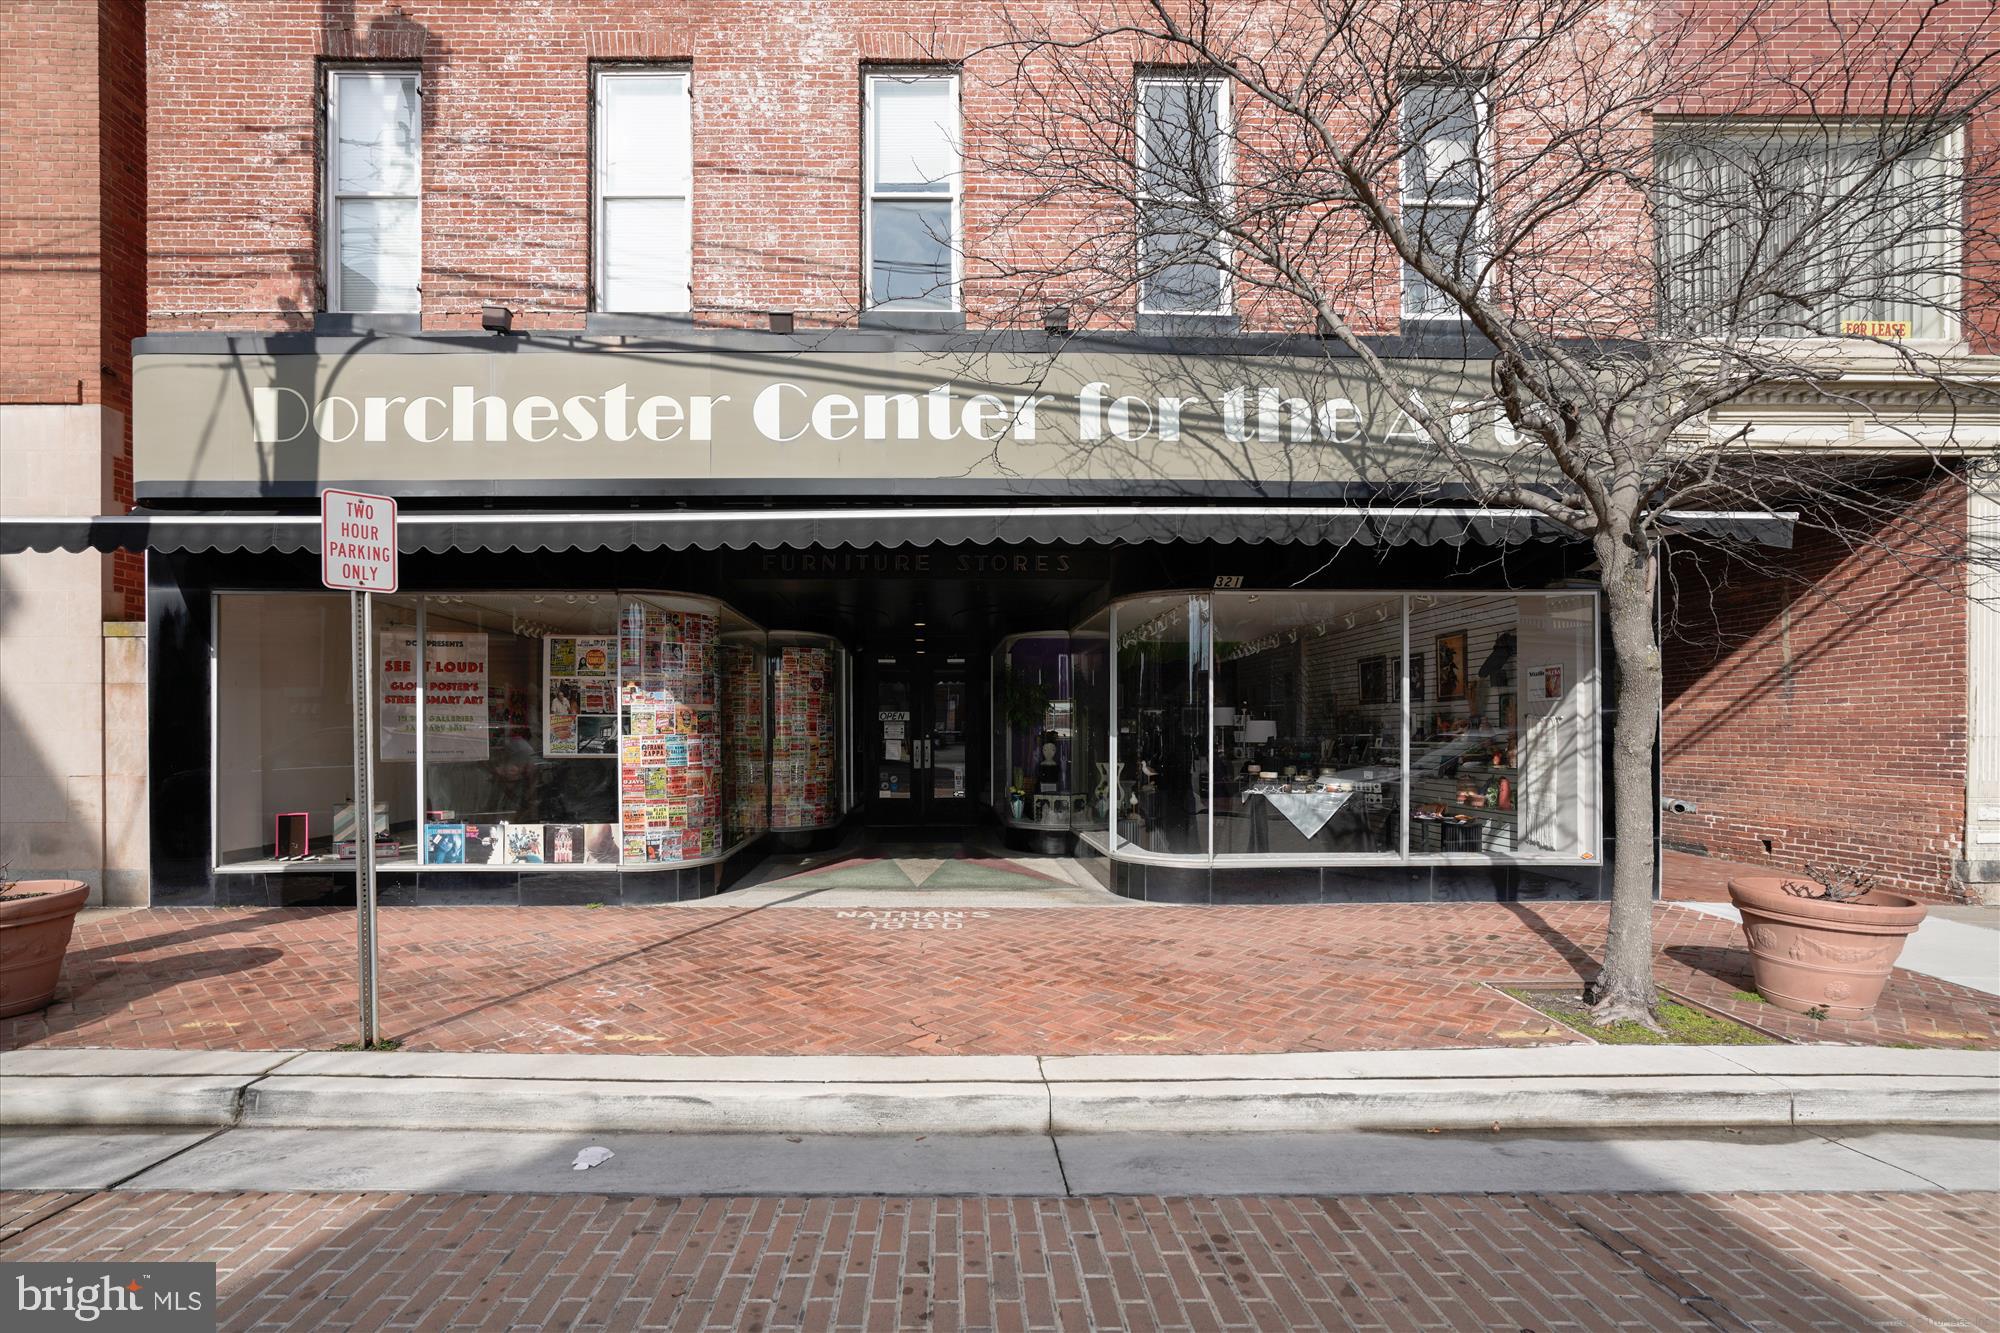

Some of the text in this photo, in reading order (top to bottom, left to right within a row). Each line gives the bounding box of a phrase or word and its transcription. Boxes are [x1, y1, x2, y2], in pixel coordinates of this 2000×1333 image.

[1846, 323, 1906, 336] FOR LEASE
[253, 381, 1550, 446] Dorchester Center for the Art
[346, 502, 374, 520] TWO
[341, 522, 378, 540] HOUR
[330, 541, 390, 562] PARKING
[761, 554, 1071, 572] FURNITURE STORES
[342, 563, 378, 581] ONLY
[1215, 576, 1240, 588] 321
[426, 640, 464, 648] PRESENTS
[384, 661, 411, 673] SEE
[435, 661, 484, 673] LOUD!
[430, 682, 479, 692] POSTER'S
[384, 695, 484, 705] STREE SMART ART
[880, 712, 905, 720] OPEN
[836, 911, 991, 919] NATHAN'S
